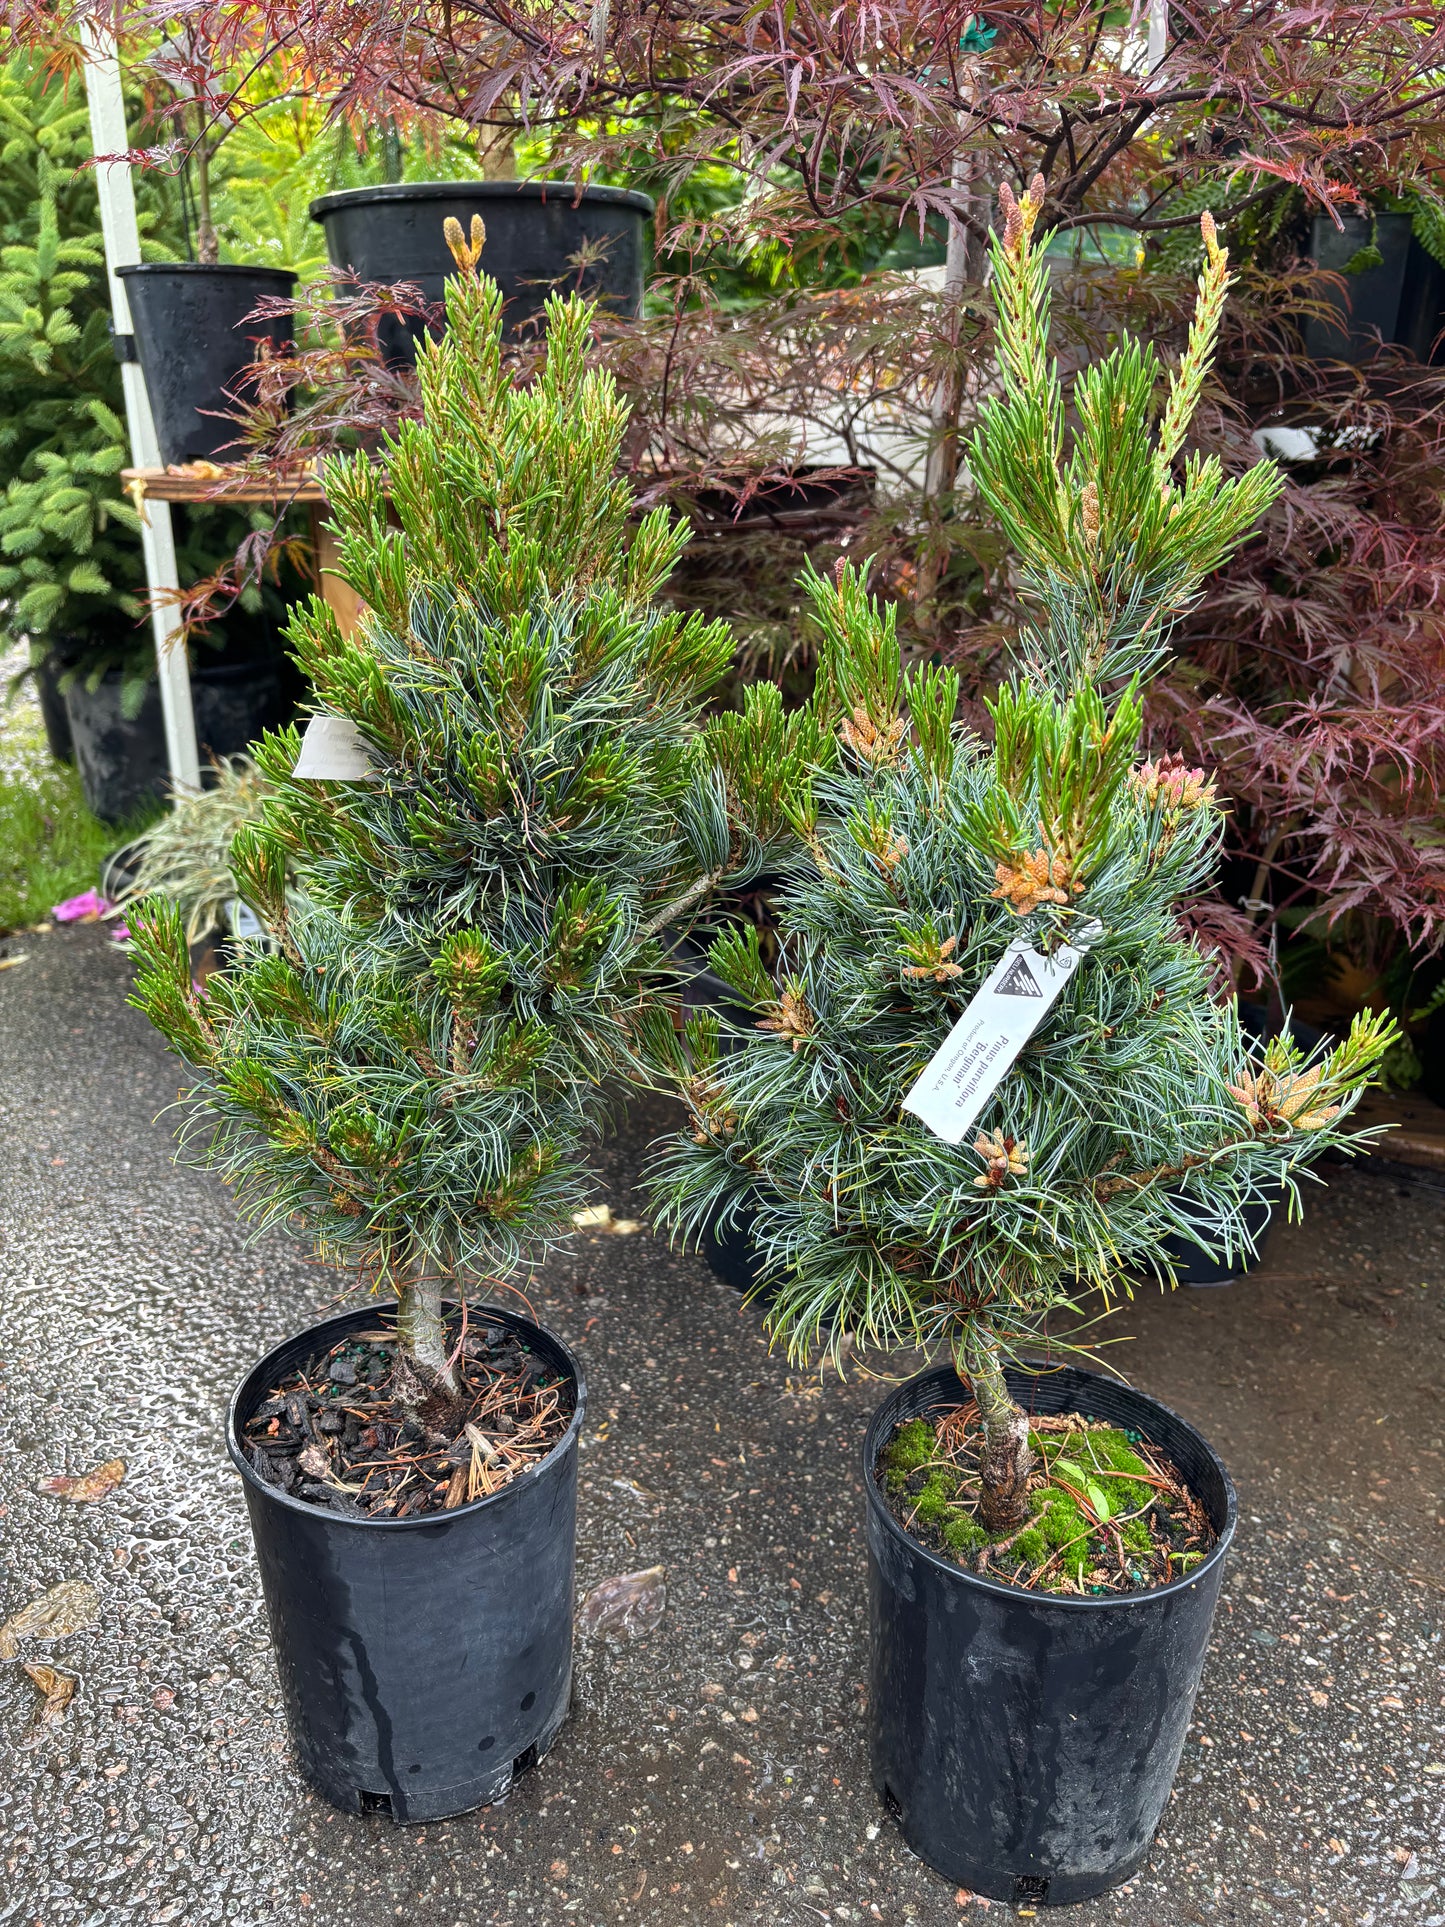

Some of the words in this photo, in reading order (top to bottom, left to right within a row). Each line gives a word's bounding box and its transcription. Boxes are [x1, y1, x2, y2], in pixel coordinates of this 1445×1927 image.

[1012, 957, 1023, 970] ISELI
[997, 969, 1015, 993] NURSERY
[967, 1019, 985, 1042] Product
[962, 1042, 967, 1050] of
[986, 1034, 1009, 1062] Pinus
[945, 1049, 964, 1071] Oregon,
[952, 1042, 988, 1088] 'Bergman'
[932, 1073, 948, 1091] U.S.A.
[955, 1060, 989, 1107] parviflora
